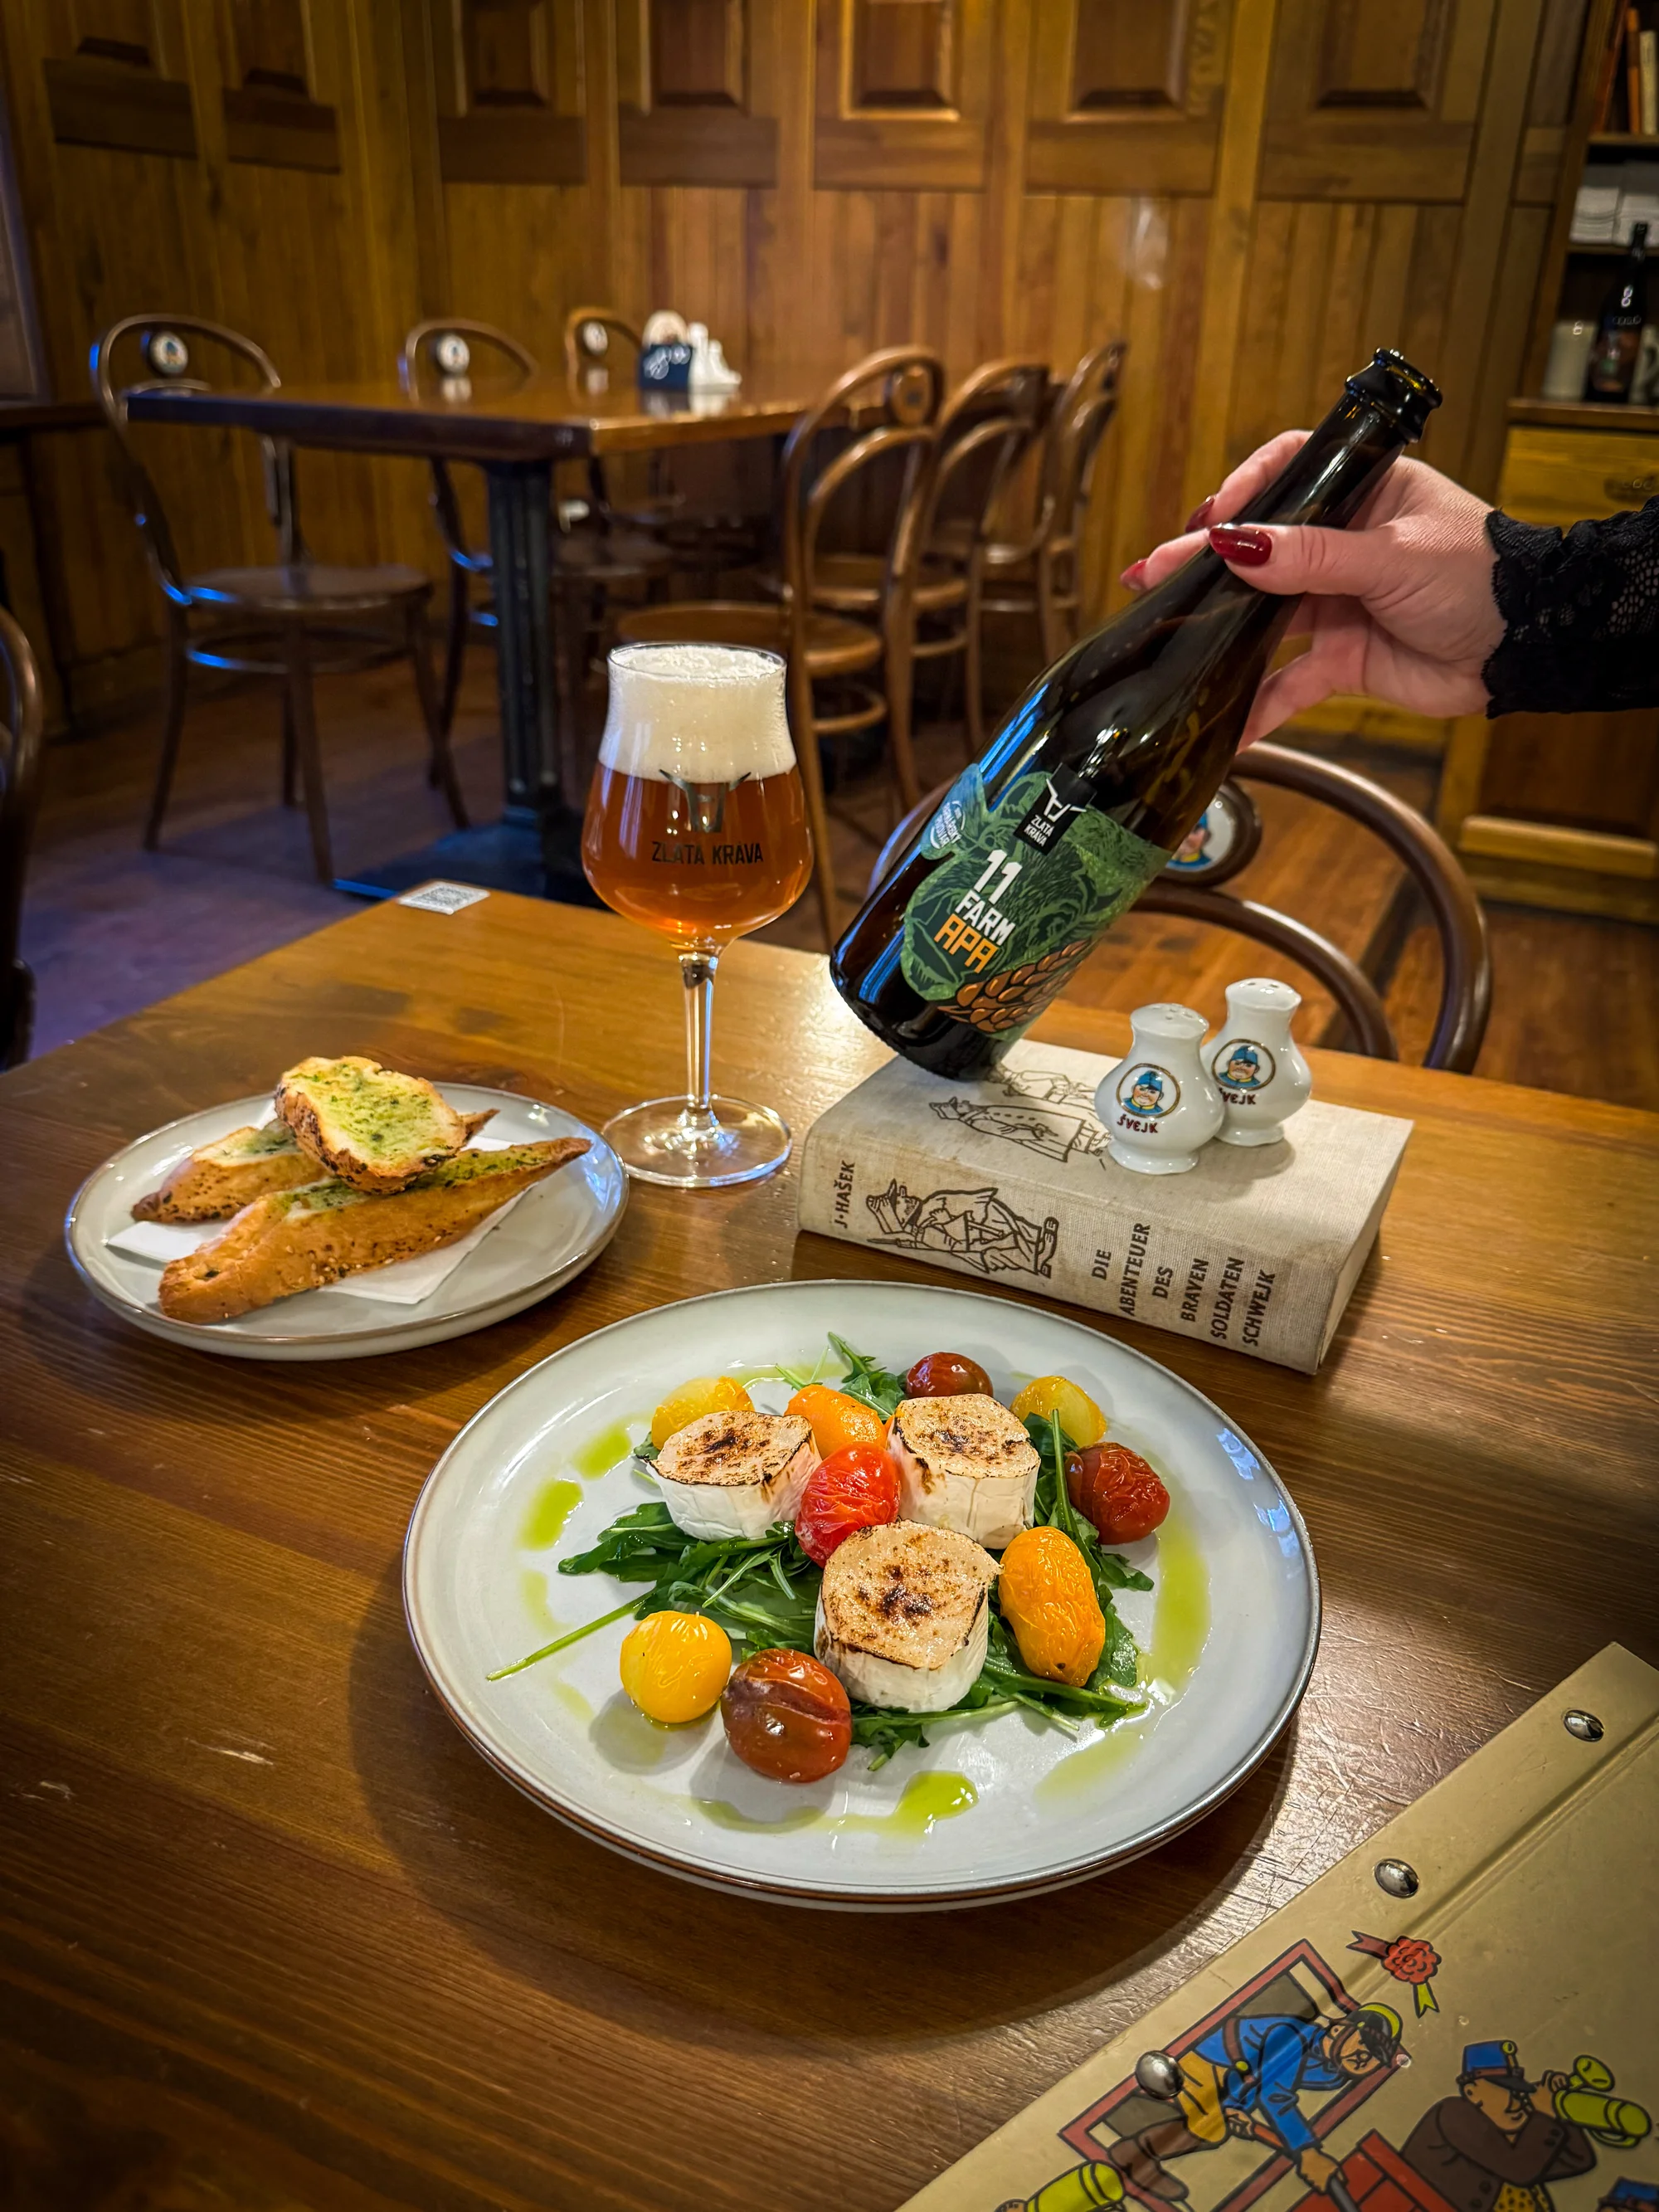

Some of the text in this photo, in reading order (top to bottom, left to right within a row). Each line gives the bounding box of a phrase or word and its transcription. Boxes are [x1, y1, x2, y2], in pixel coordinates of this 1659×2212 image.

[973, 849, 1023, 905] 11
[933, 913, 1000, 973] APA
[955, 889, 1016, 946] FARM
[1092, 1249, 1112, 1280] DIE
[1119, 1222, 1151, 1317] ABENTEUER
[1152, 1266, 1173, 1299] DES
[1180, 1258, 1209, 1322] BRAVEN
[1210, 1256, 1244, 1340] SOLDATEN
[1242, 1269, 1276, 1347] SCHWEJK
